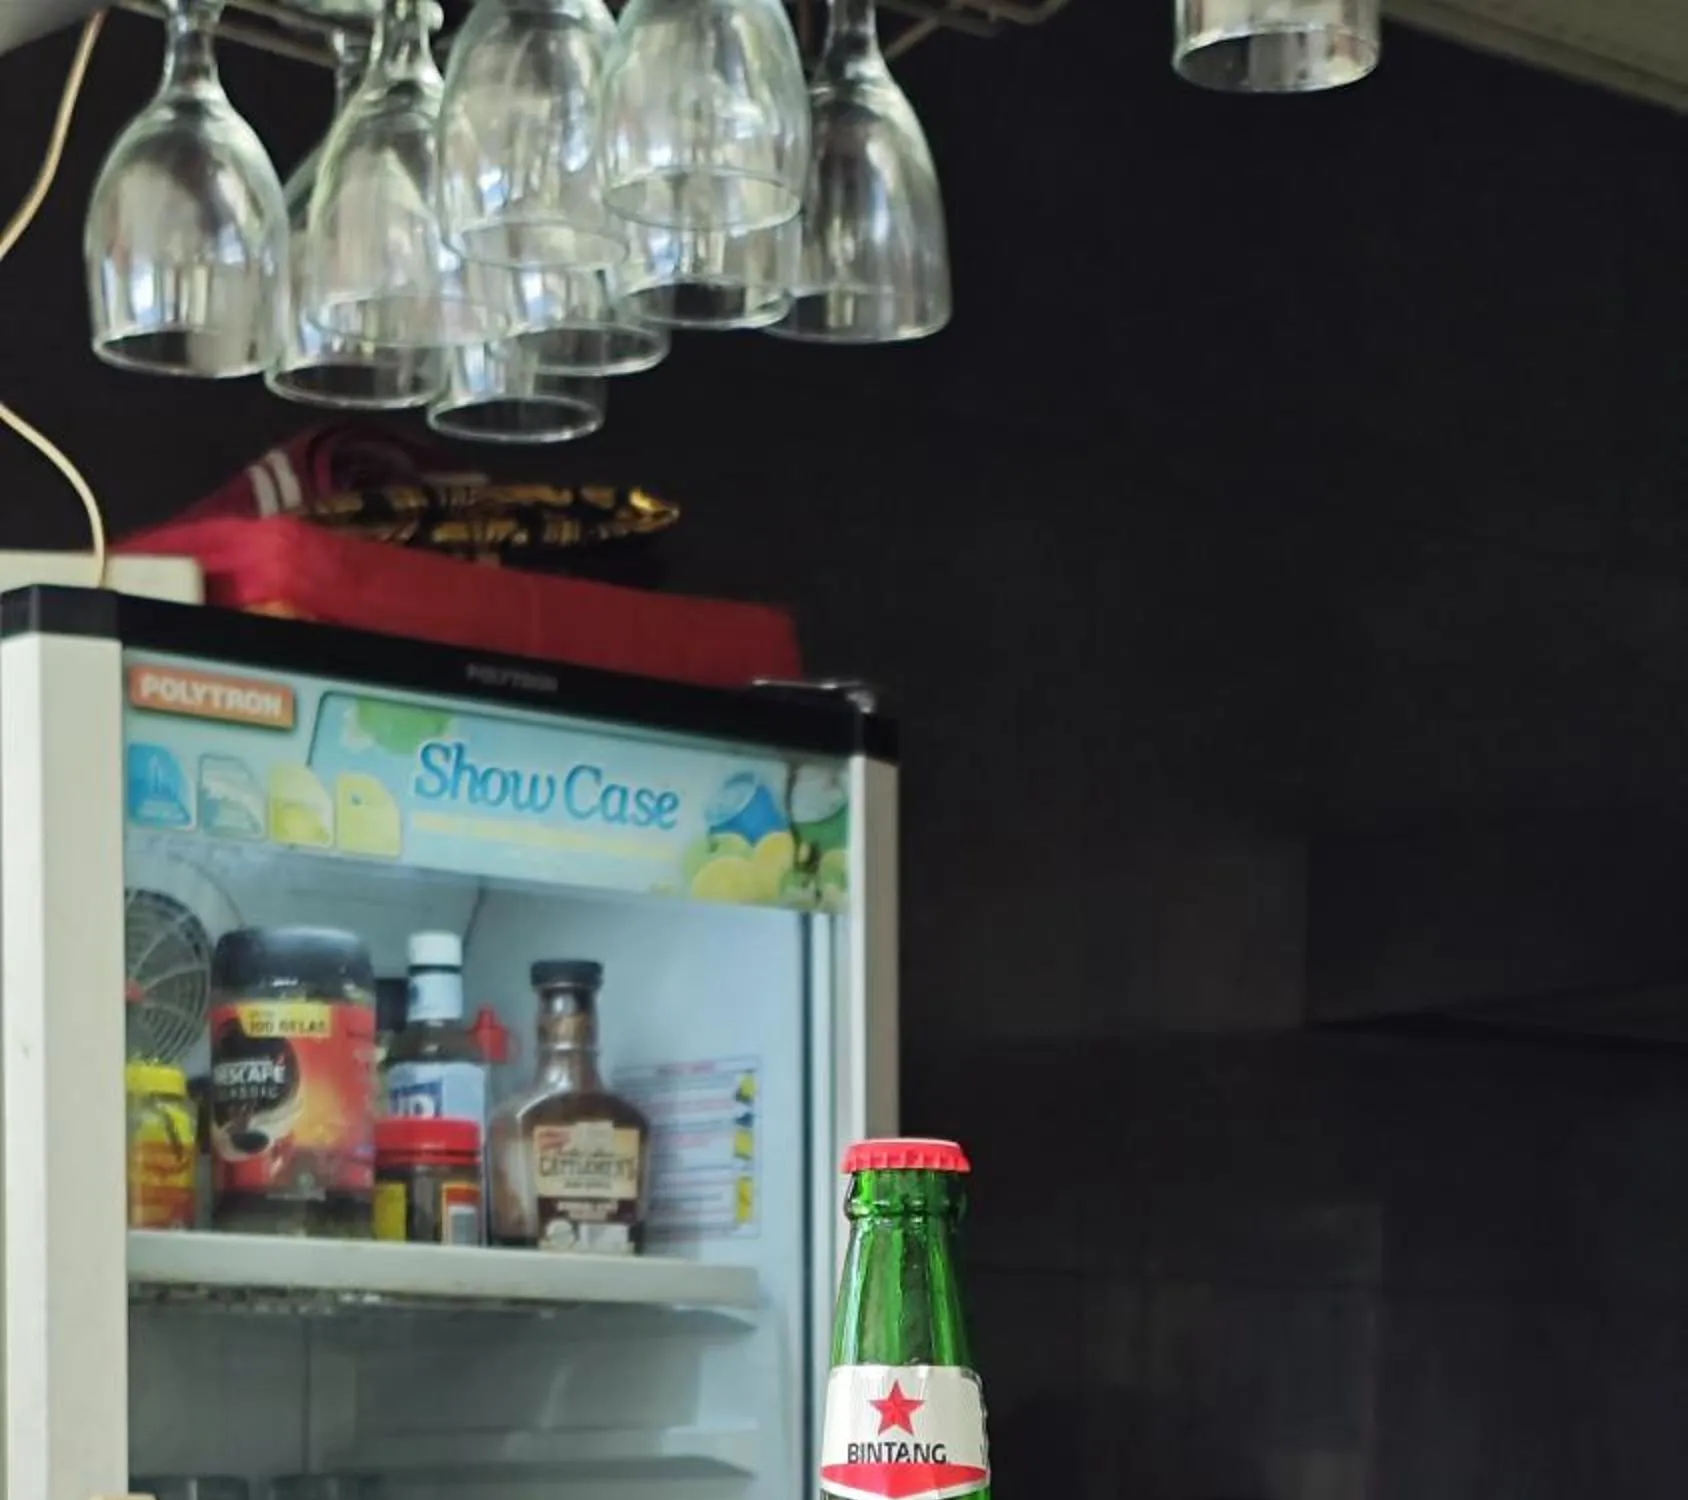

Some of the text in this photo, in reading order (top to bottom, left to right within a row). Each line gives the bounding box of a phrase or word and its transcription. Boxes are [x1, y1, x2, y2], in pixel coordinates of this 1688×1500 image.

[140, 674, 283, 718] POLYTRON
[414, 740, 680, 830] Show Case
[847, 1441, 948, 1465] BINTANG
